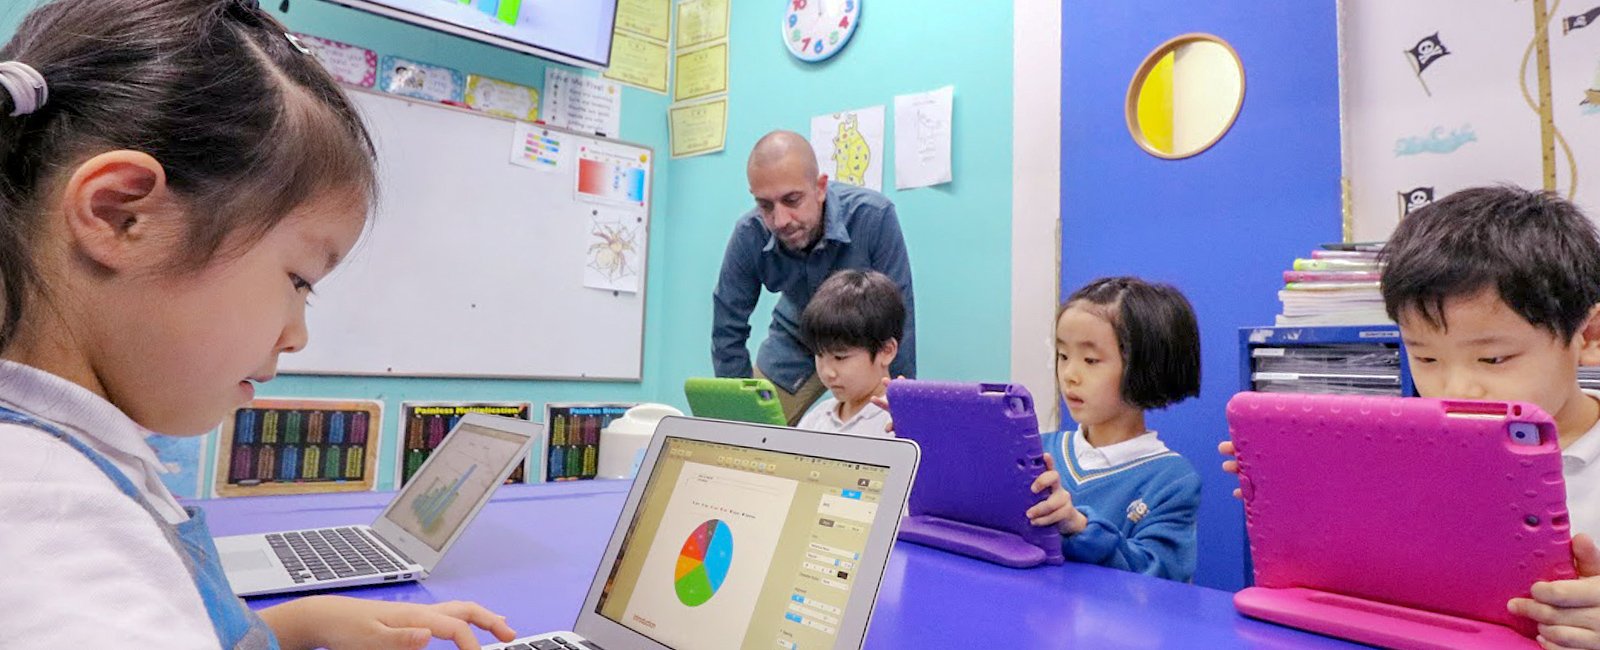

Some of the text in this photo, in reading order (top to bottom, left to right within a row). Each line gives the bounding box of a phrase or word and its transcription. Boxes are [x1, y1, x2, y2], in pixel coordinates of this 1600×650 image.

[789, 14, 797, 28] 9
[839, 16, 849, 29] 4
[802, 38, 811, 52] 7
[829, 31, 839, 45] 5
[814, 40, 823, 54] 6
[415, 406, 454, 415] Painless
[569, 406, 602, 415] Painless
